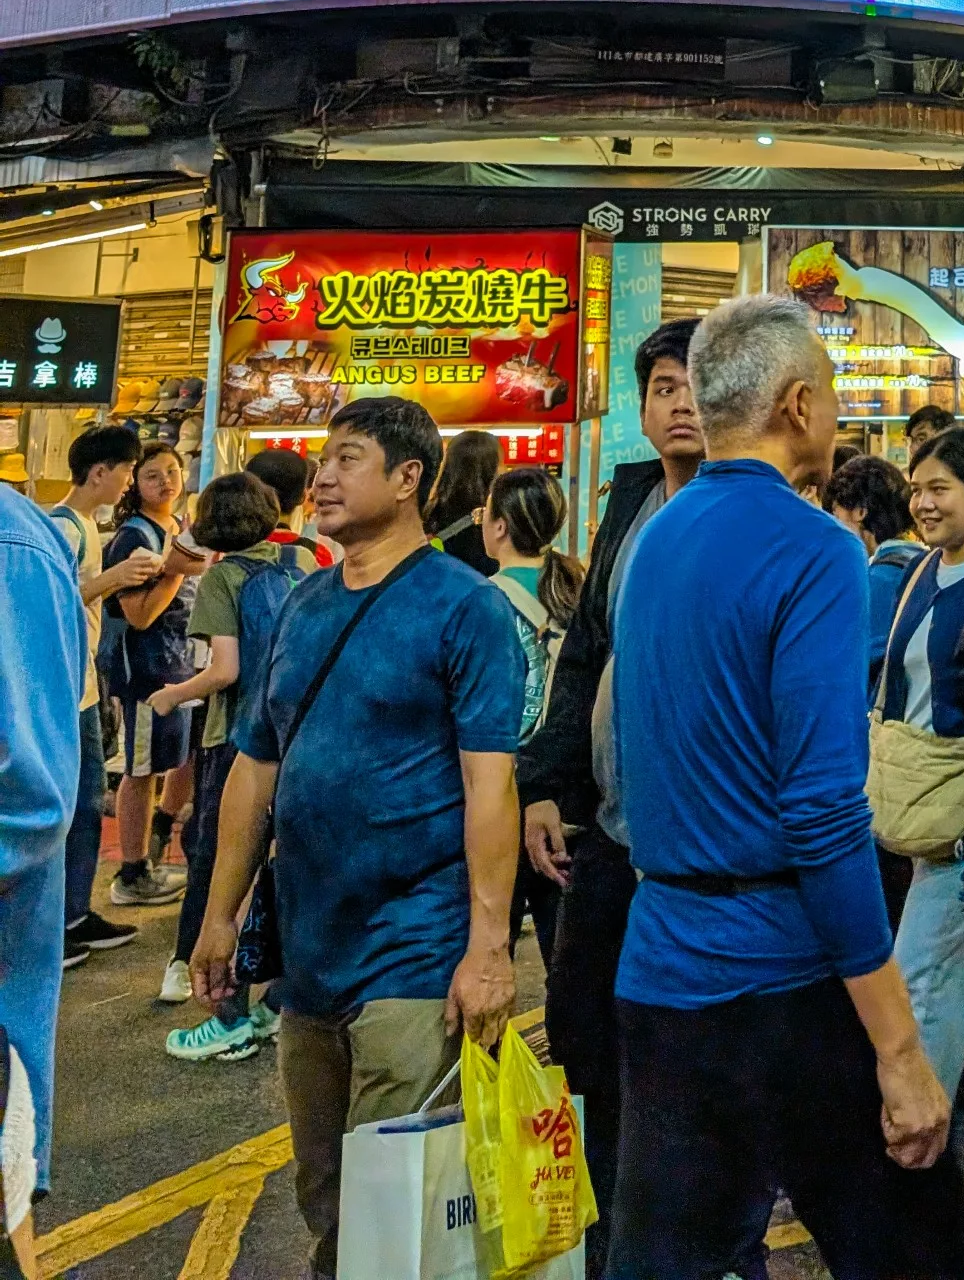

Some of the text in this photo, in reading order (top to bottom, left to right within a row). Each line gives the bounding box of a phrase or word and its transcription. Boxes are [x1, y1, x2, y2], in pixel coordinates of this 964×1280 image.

[632, 207, 772, 222] STRONG CARRY
[319, 269, 568, 324] 火焰炭燒牛
[352, 336, 470, 358] 큐브스테이크
[0, 359, 98, 389] 吉拿棒
[331, 365, 486, 384] ANGUS BEEF
